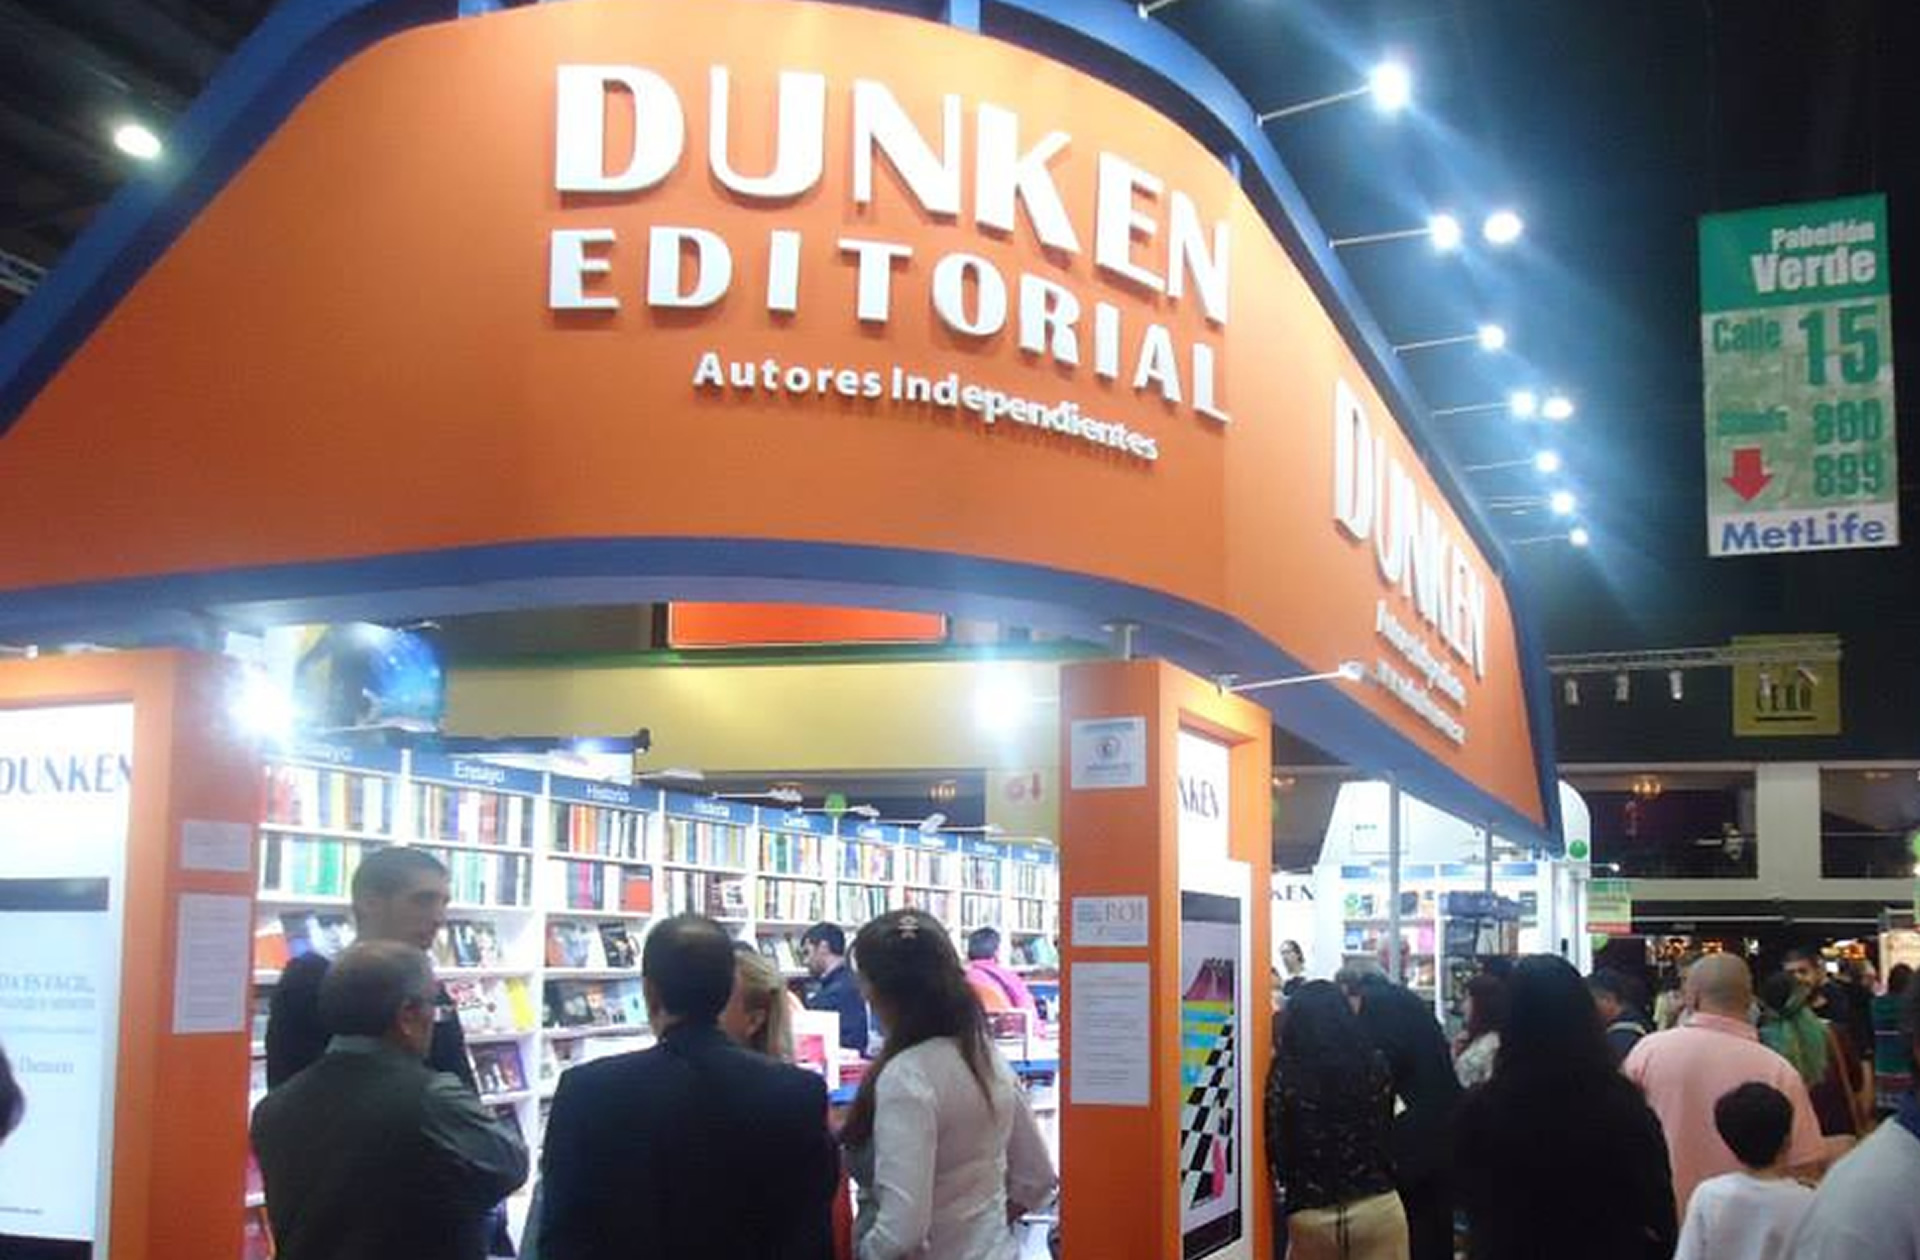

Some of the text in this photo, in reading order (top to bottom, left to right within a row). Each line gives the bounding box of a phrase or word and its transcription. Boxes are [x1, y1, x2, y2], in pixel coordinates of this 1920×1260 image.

[554, 64, 1230, 326] DUNKEN
[1752, 246, 1876, 293] Verde
[547, 226, 1229, 426] EDITORIAL
[1713, 306, 1880, 387] Calle 15
[693, 351, 1159, 462] Autores Independientes
[1334, 376, 1486, 680] DUNKEN
[1722, 513, 1887, 551] MetLife
